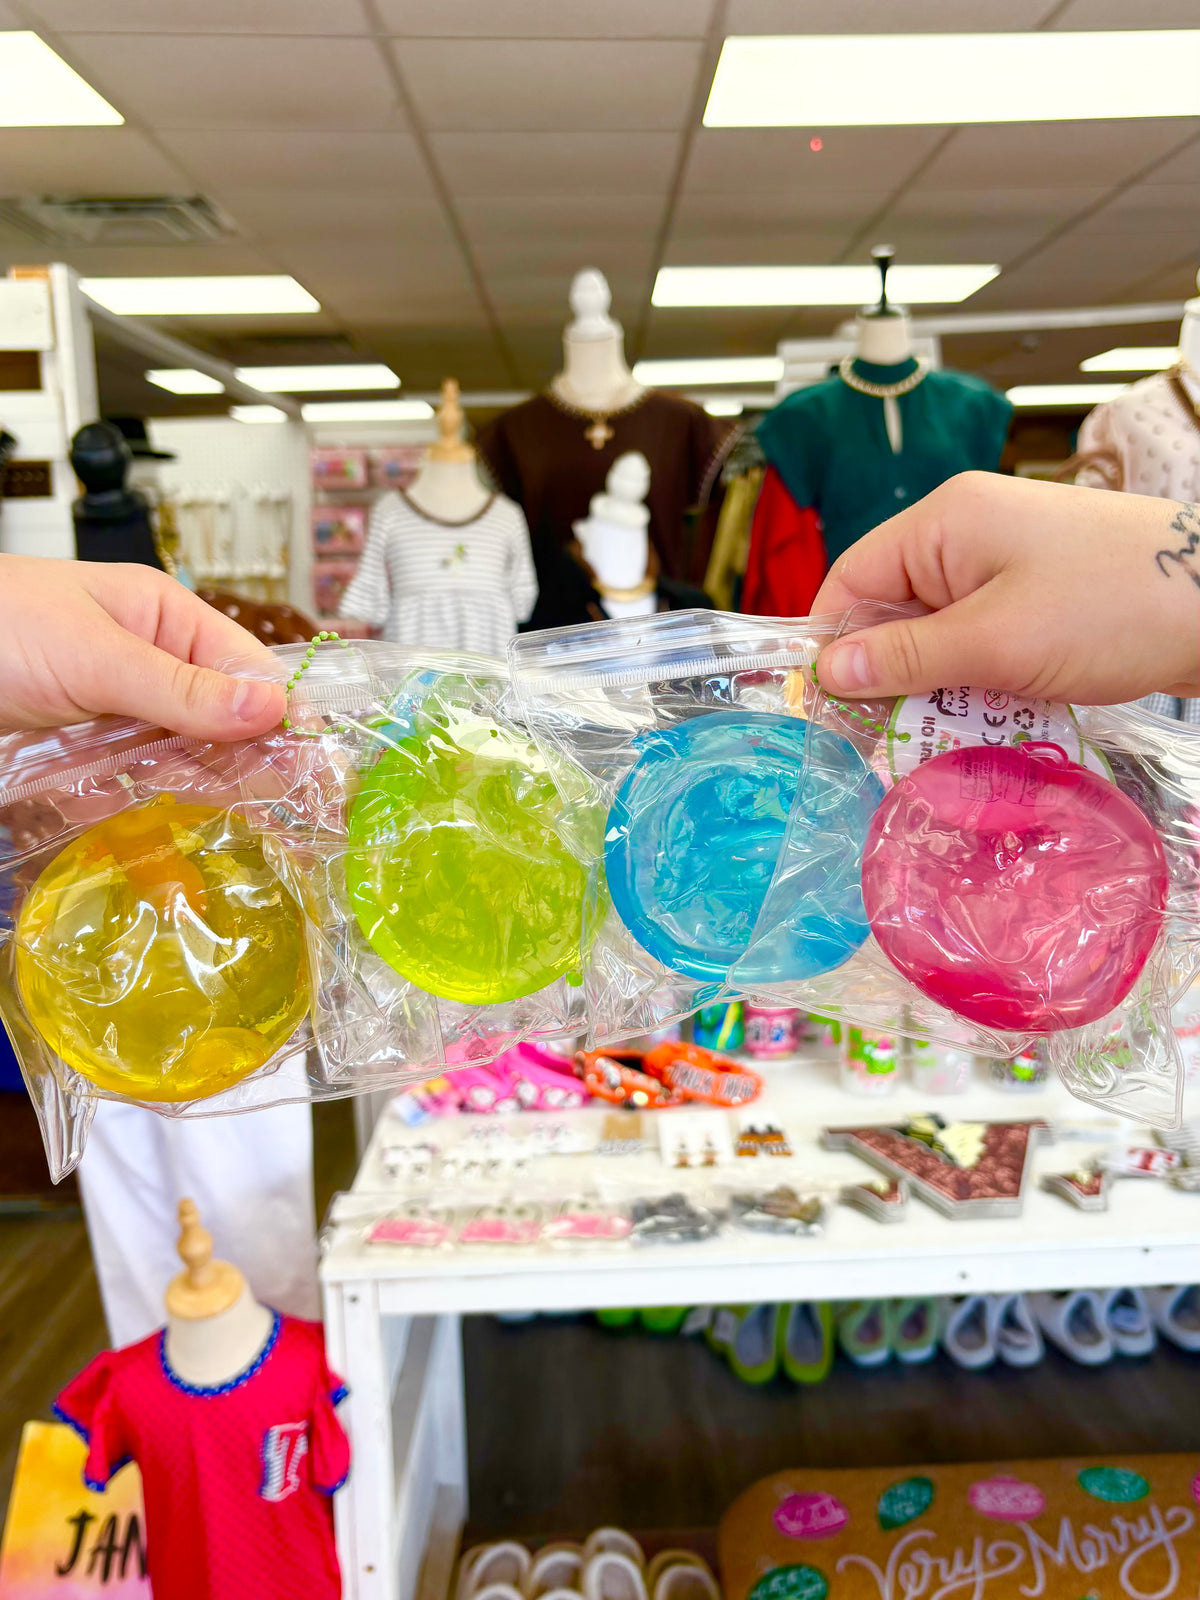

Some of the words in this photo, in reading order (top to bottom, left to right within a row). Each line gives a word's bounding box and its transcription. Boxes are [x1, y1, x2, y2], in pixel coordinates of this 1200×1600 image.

[920, 716, 936, 737] Oil
[982, 711, 1007, 746] CE
[836, 1530, 1024, 1600] Very
[1018, 1504, 1194, 1599] Merry
